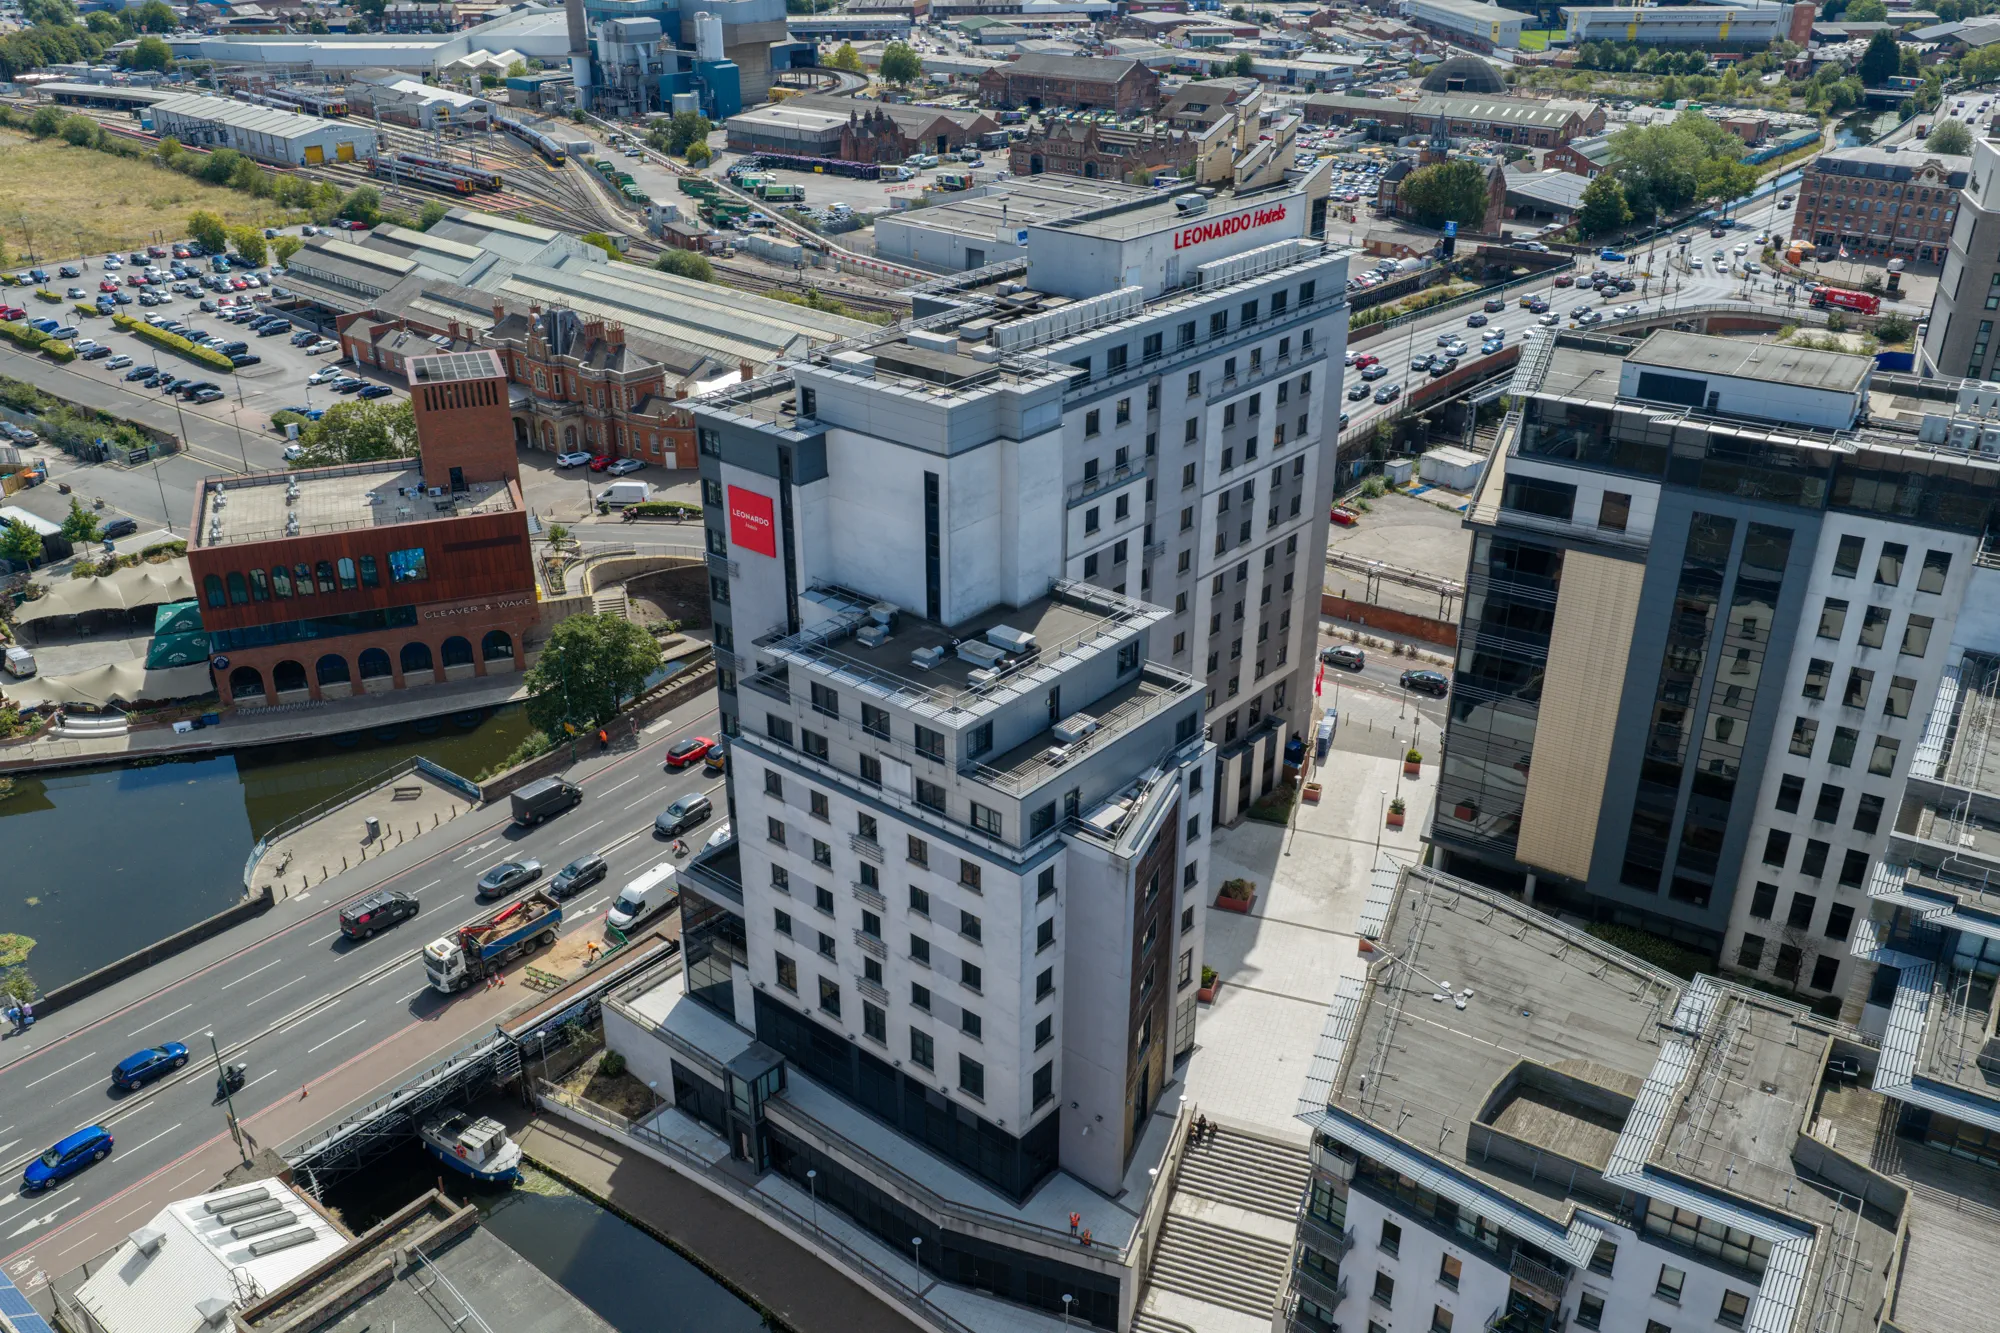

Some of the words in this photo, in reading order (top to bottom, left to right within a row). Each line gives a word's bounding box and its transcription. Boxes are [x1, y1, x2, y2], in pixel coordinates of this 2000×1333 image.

[1174, 213, 1251, 250] LEONARDO
[1252, 203, 1287, 229] Hotels
[732, 508, 769, 527] LEONARDO
[423, 605, 479, 619] CLEAVER
[497, 598, 531, 609] WAKE
